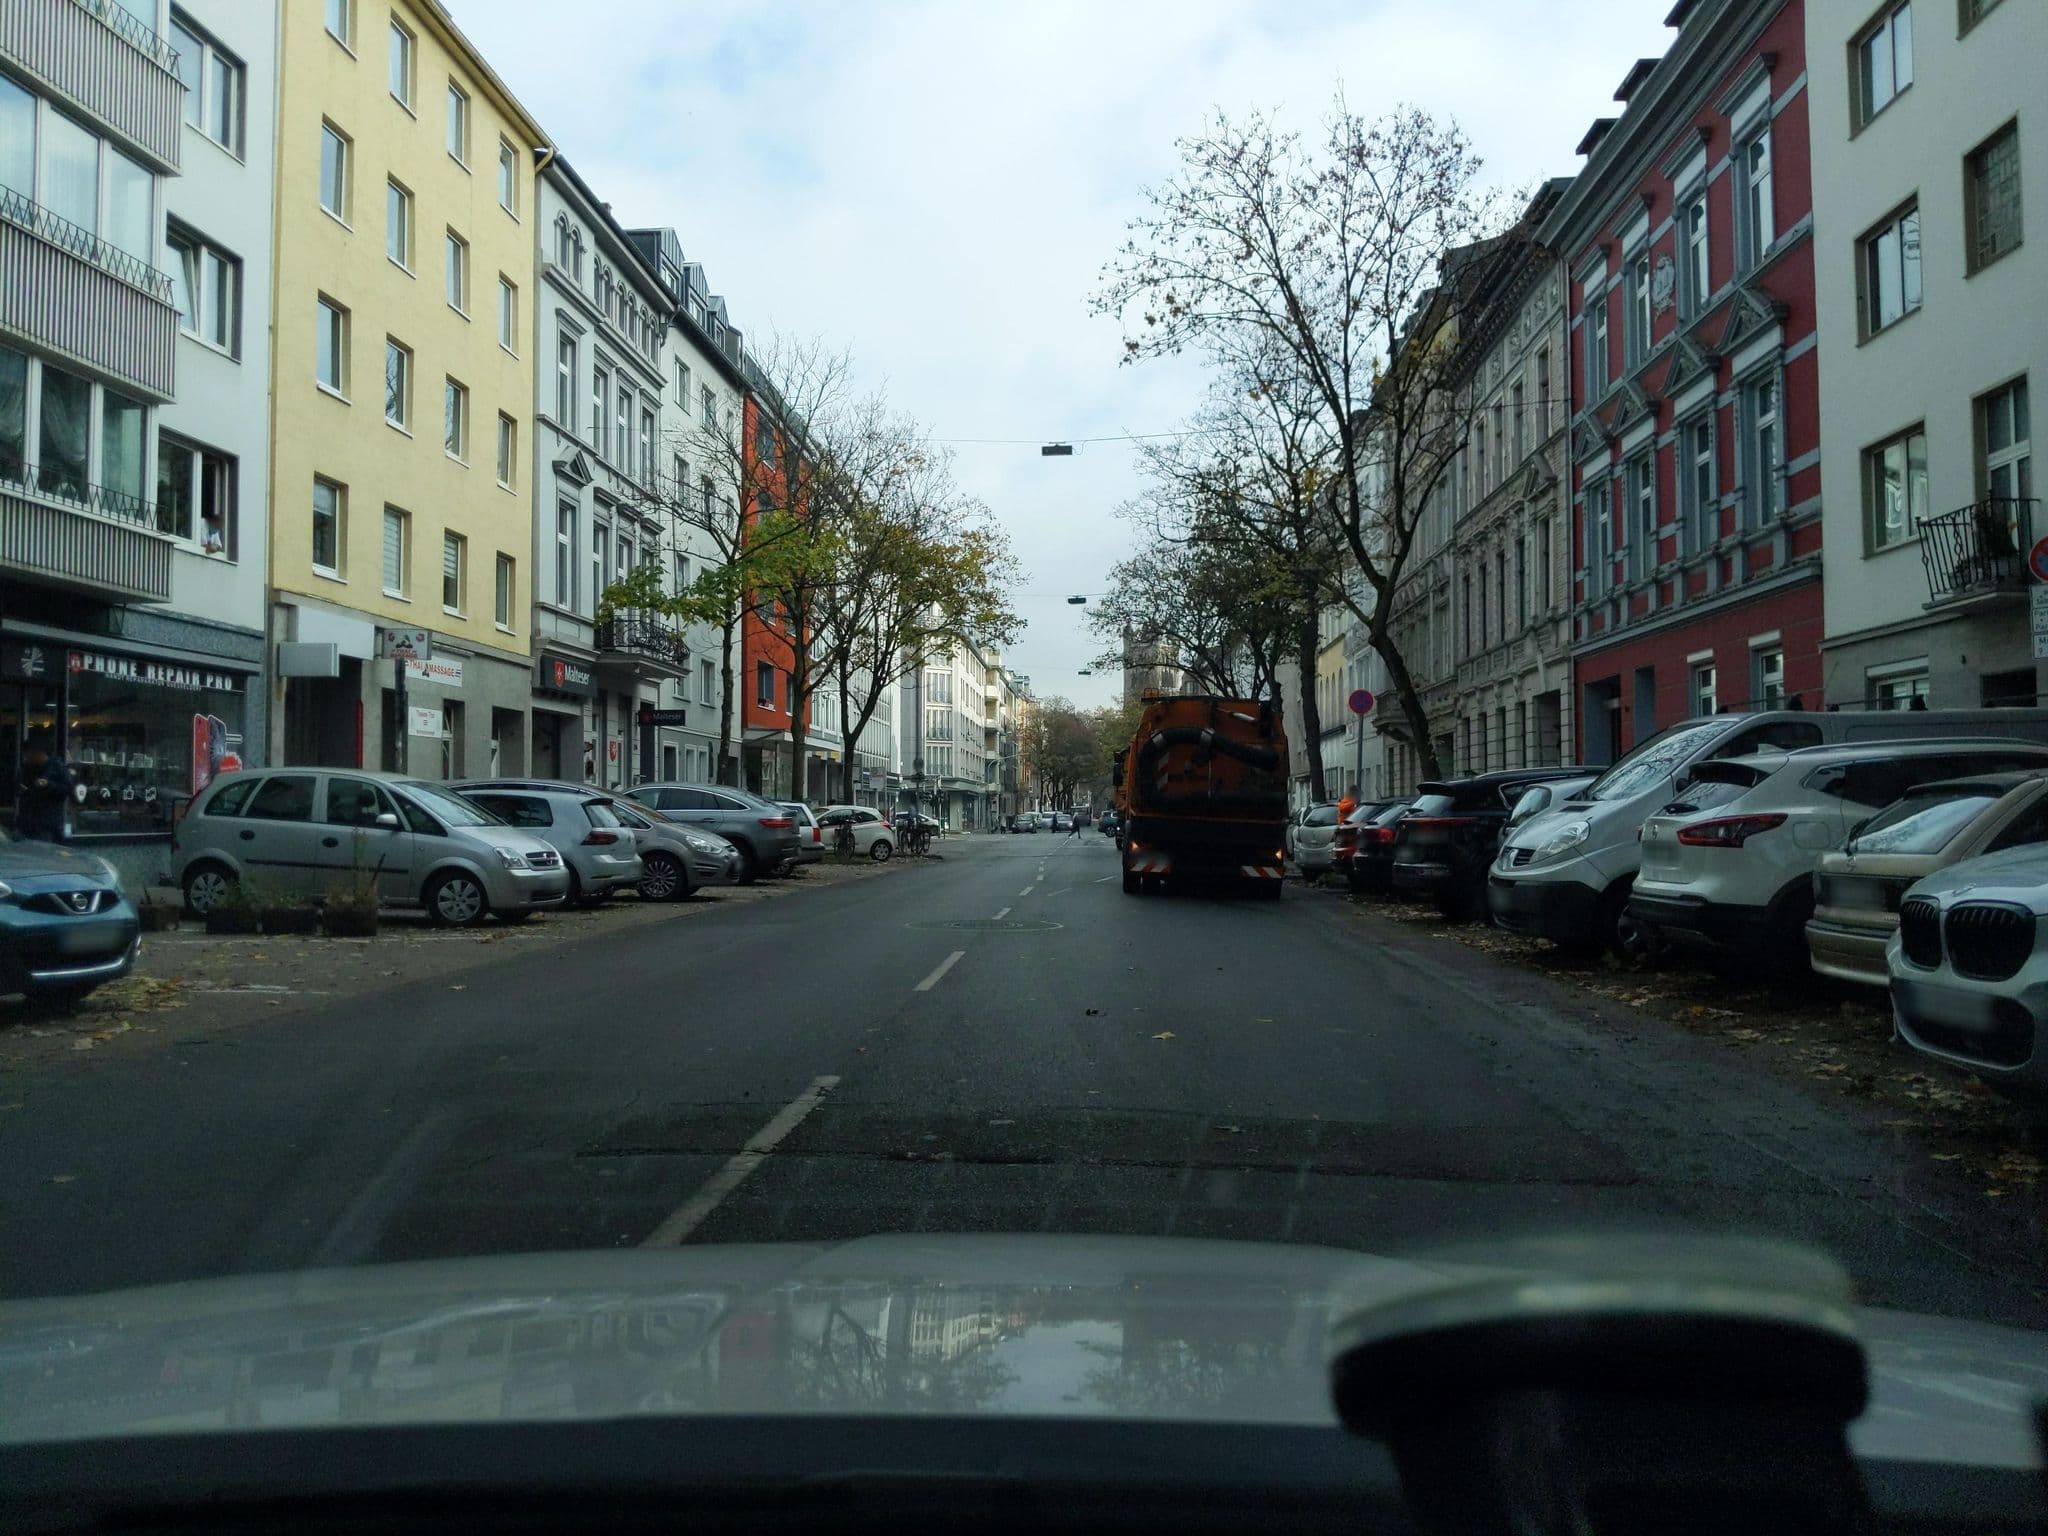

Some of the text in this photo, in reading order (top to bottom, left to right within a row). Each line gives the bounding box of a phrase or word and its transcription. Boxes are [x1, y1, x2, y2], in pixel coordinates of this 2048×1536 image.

[83, 655, 233, 691] PHONE REPAIR PRO
[428, 663, 455, 677] MASSAGE
[564, 664, 590, 686] Malteser
[653, 712, 681, 721] Malteser
